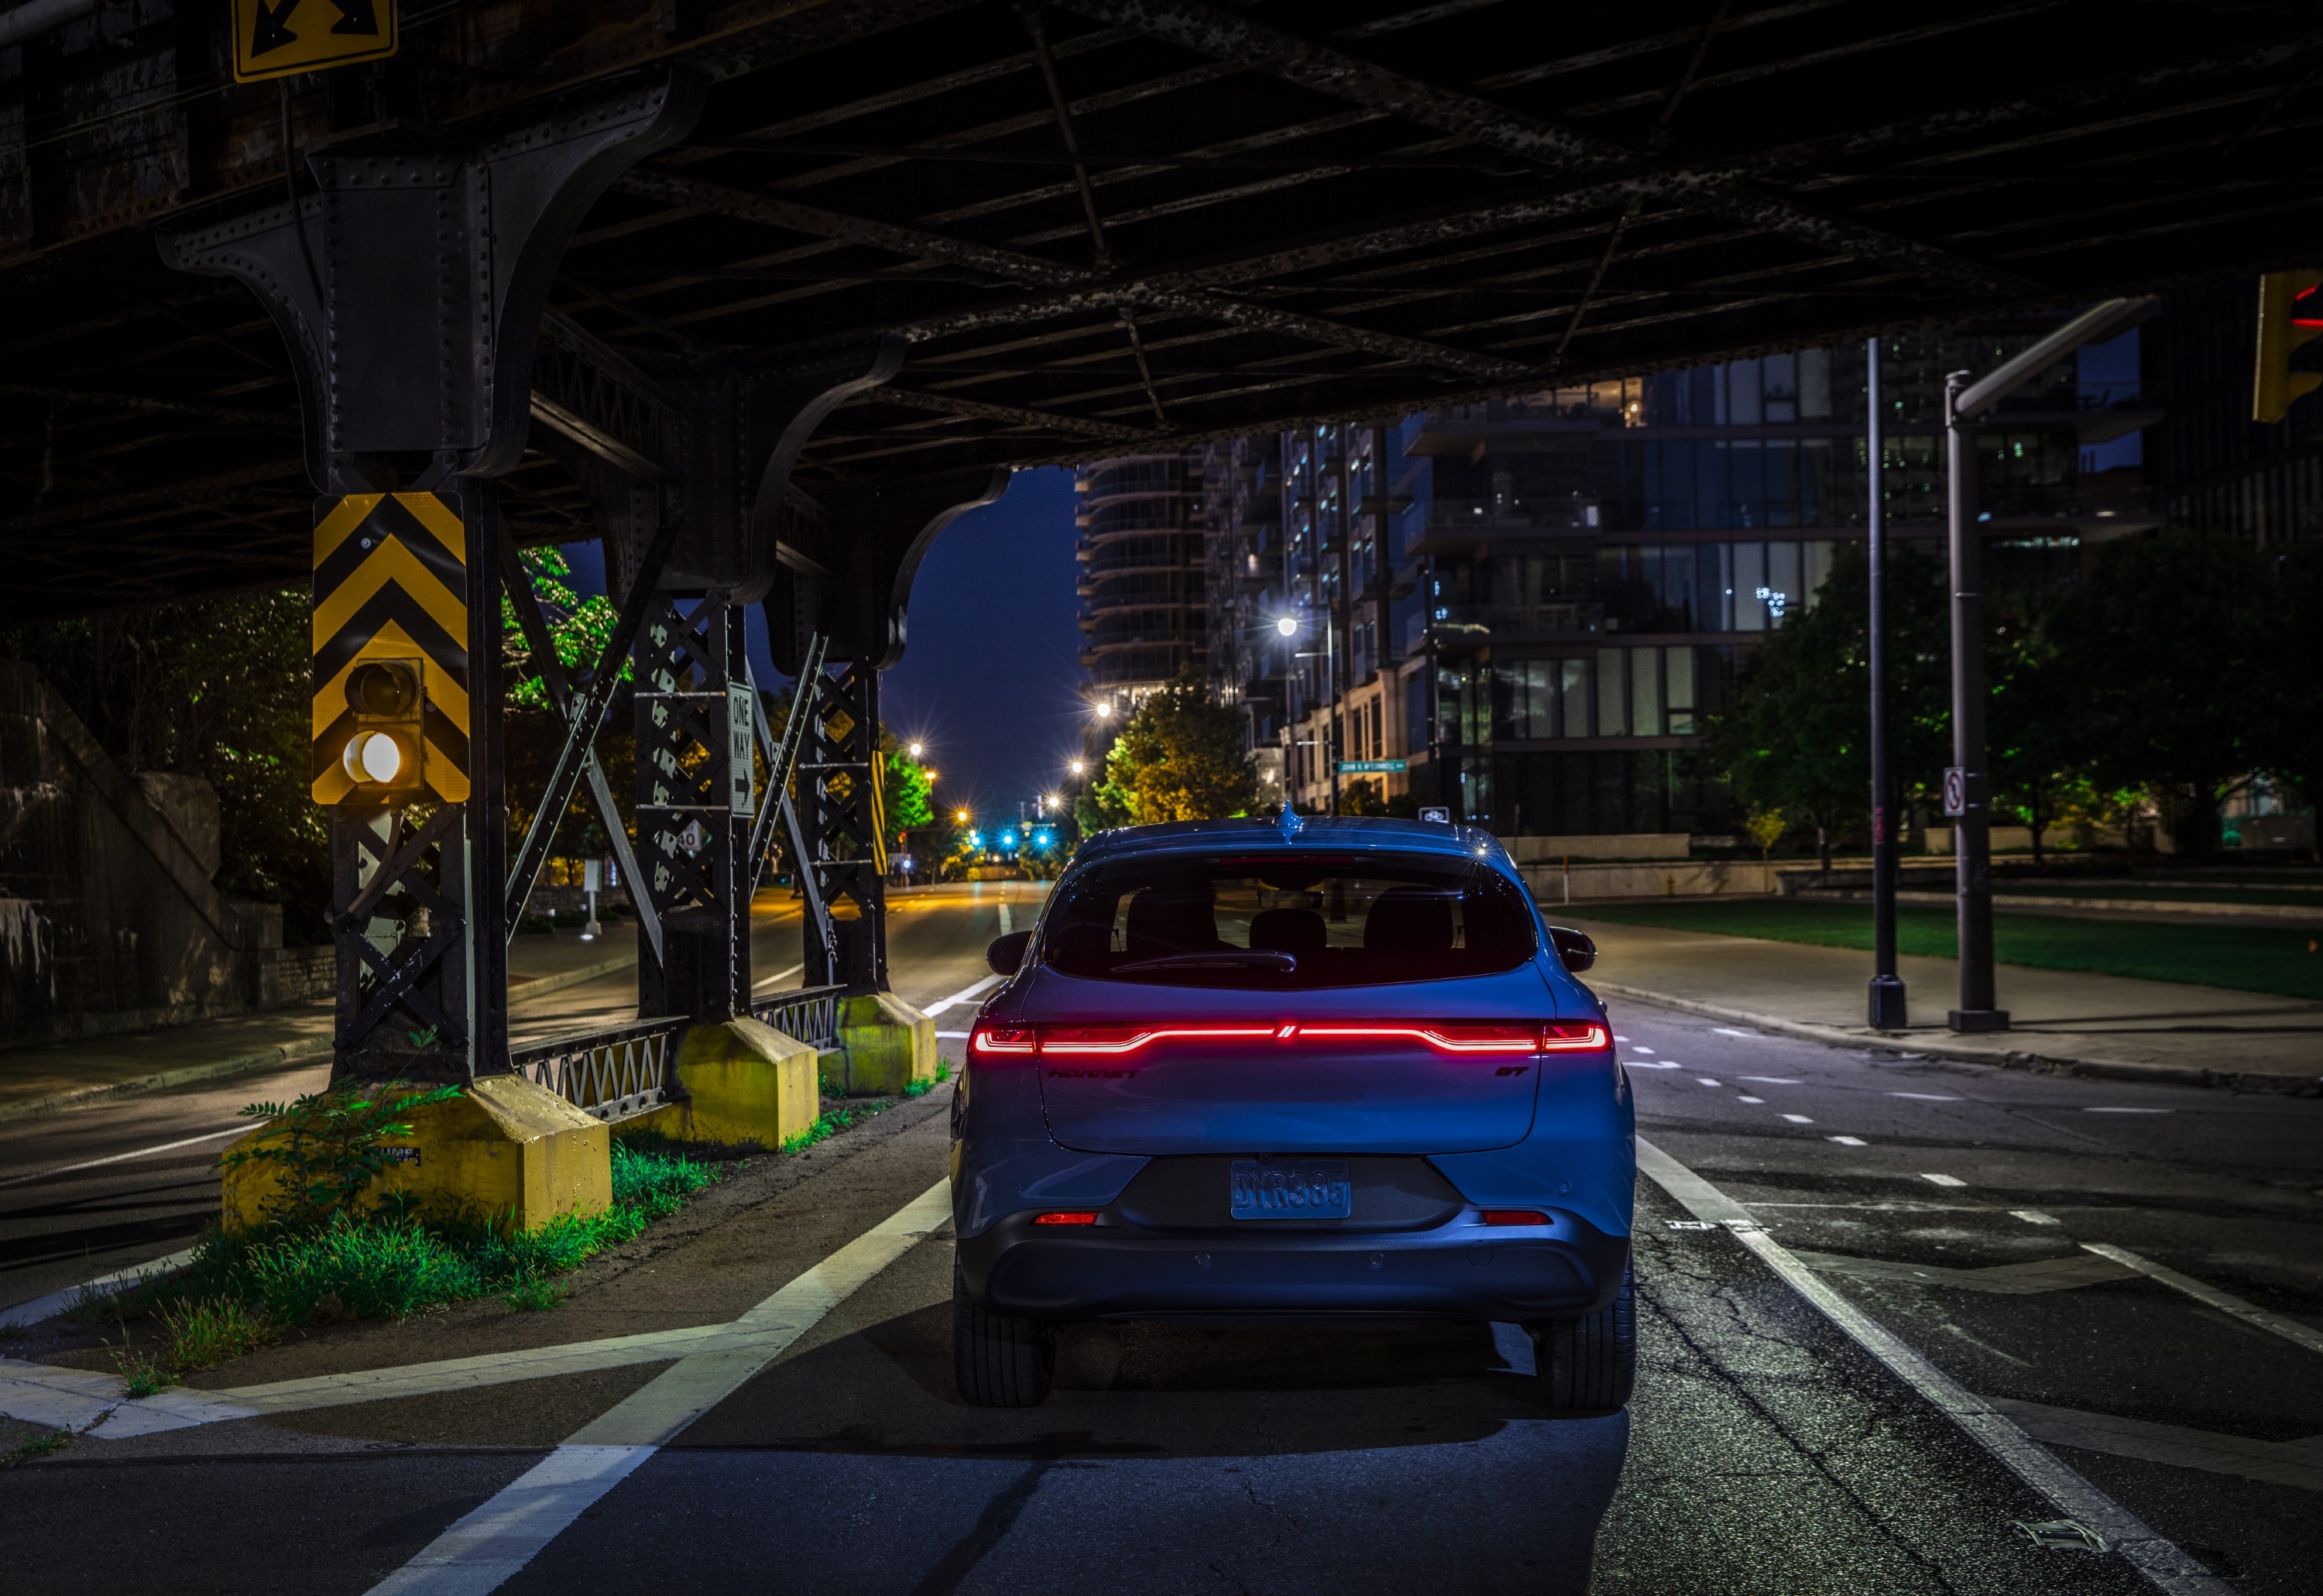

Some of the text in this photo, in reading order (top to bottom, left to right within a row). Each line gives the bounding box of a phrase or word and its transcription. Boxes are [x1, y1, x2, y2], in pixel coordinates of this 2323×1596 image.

[733, 695, 749, 726] ONE
[733, 730, 750, 760] WAY
[677, 832, 695, 846] 40
[1047, 1069, 1141, 1079] HORNET
[1494, 1066, 1529, 1077] GT
